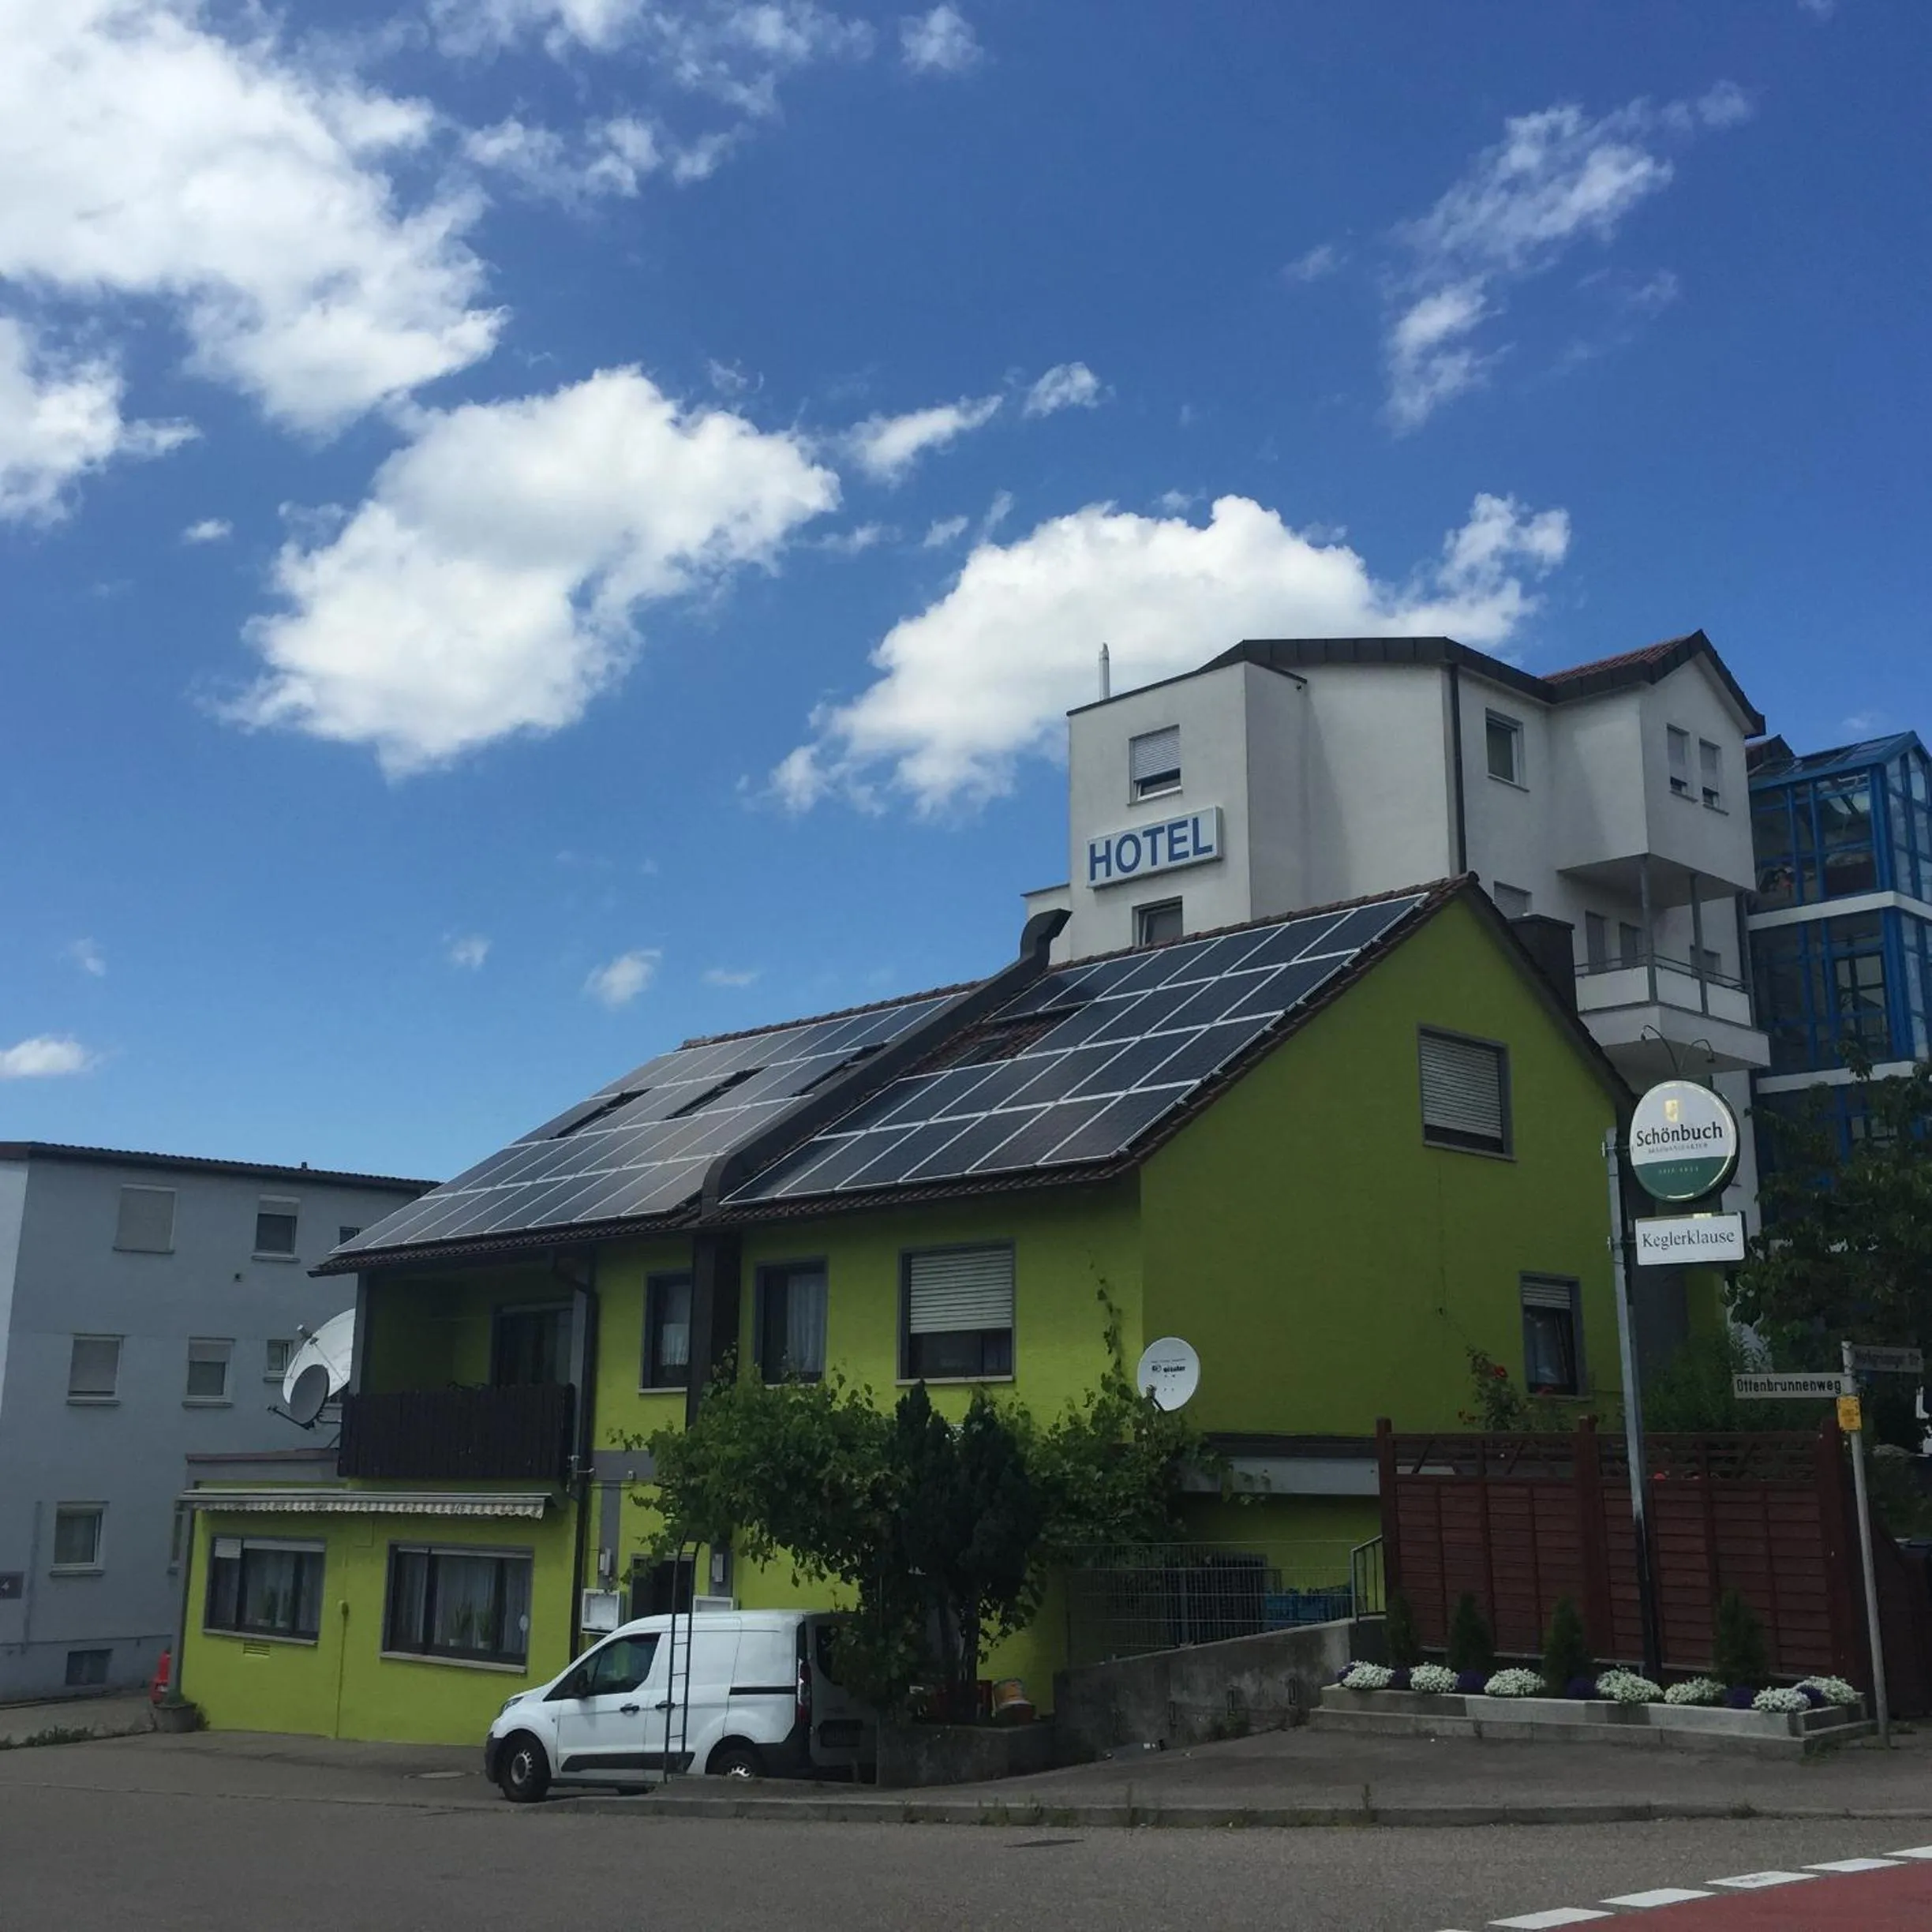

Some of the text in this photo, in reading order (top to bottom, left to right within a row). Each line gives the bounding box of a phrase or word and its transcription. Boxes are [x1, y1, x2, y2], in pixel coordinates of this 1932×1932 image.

[1089, 817, 1213, 882] HOTEL
[1636, 1121, 1724, 1148] Schönbuch
[1642, 1230, 1735, 1250] Keglerklause
[1736, 1378, 1842, 1394] Ottenbrunnenweg
